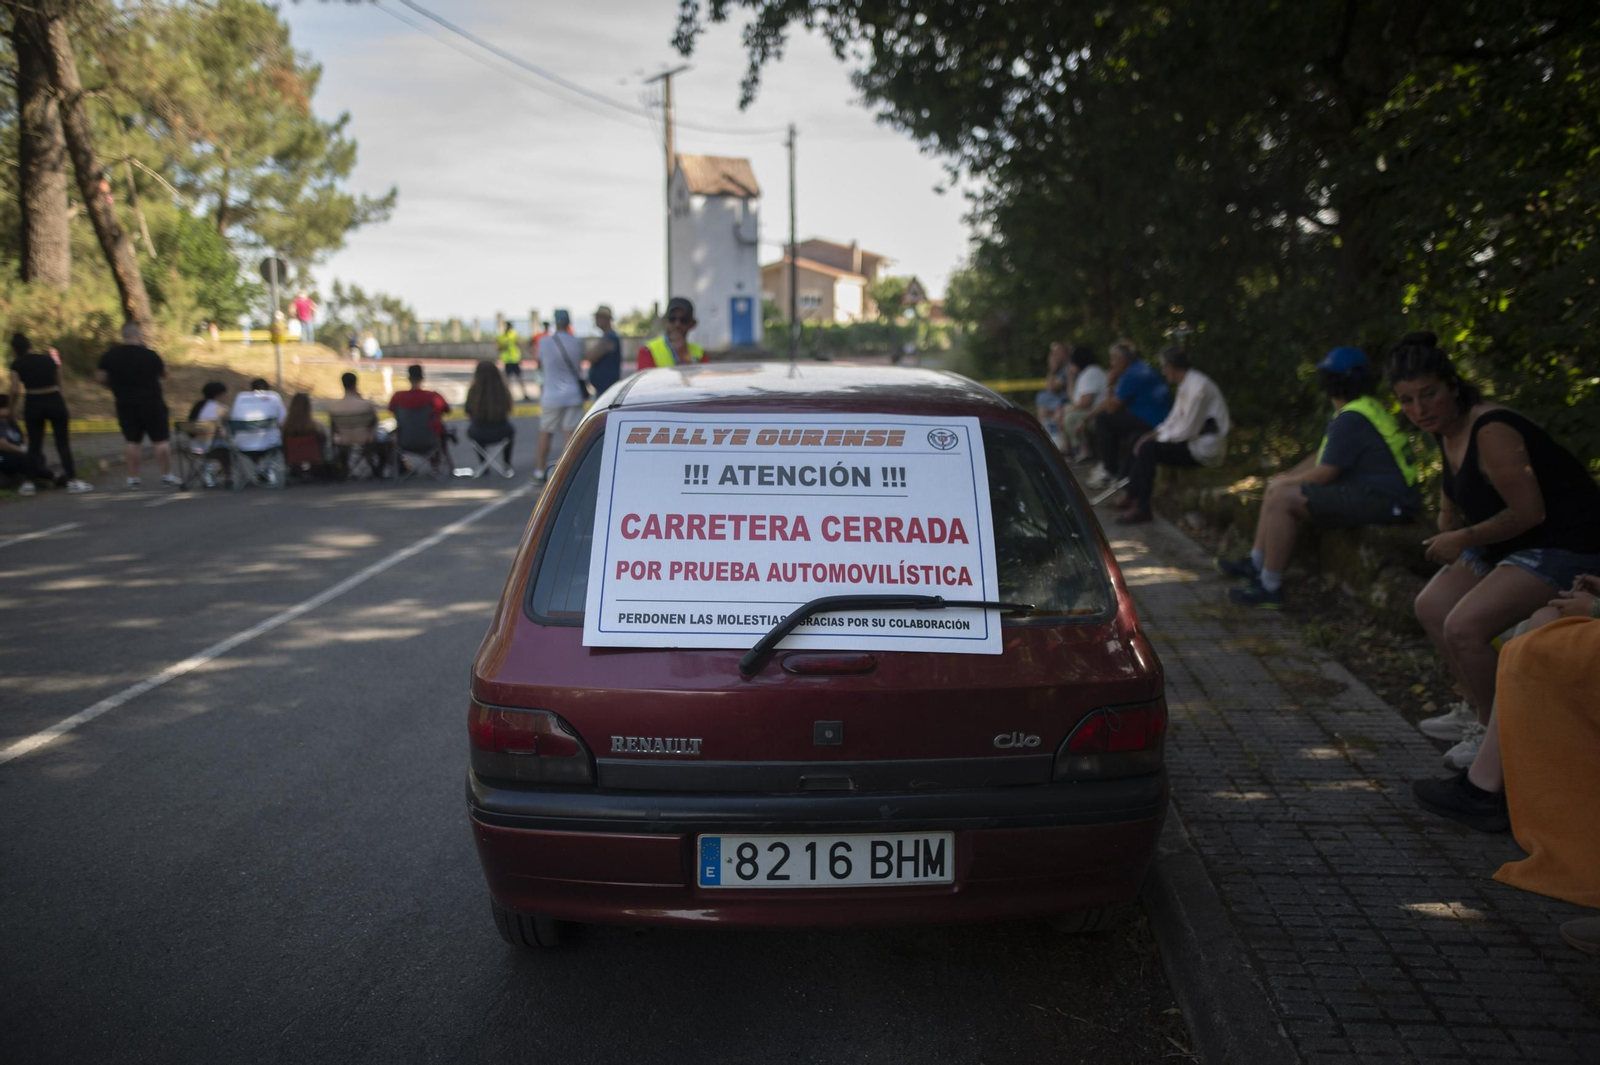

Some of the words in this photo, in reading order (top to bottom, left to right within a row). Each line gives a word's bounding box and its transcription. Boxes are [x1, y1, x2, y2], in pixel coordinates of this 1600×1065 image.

[625, 427, 750, 446] RALLYE
[755, 428, 907, 447] OURENSE
[684, 464, 709, 485] !!!
[718, 461, 871, 488] ATENCIÓN
[881, 466, 907, 488] !!!
[620, 513, 811, 542] CARRETERA
[820, 516, 969, 545] CERRADA
[615, 560, 662, 581] POR
[669, 561, 760, 582] PRUEBA
[766, 559, 973, 586] AUTOMOVILÍSTICA
[618, 612, 686, 625] PERDONEN
[689, 613, 713, 625] LAS
[847, 617, 869, 628] POR
[871, 618, 886, 628] SU
[888, 618, 970, 631] COLABORACIÓN
[610, 736, 703, 754] RENAULT
[735, 841, 854, 881] 8216
[870, 838, 946, 879] BHM
[705, 866, 716, 878] E
